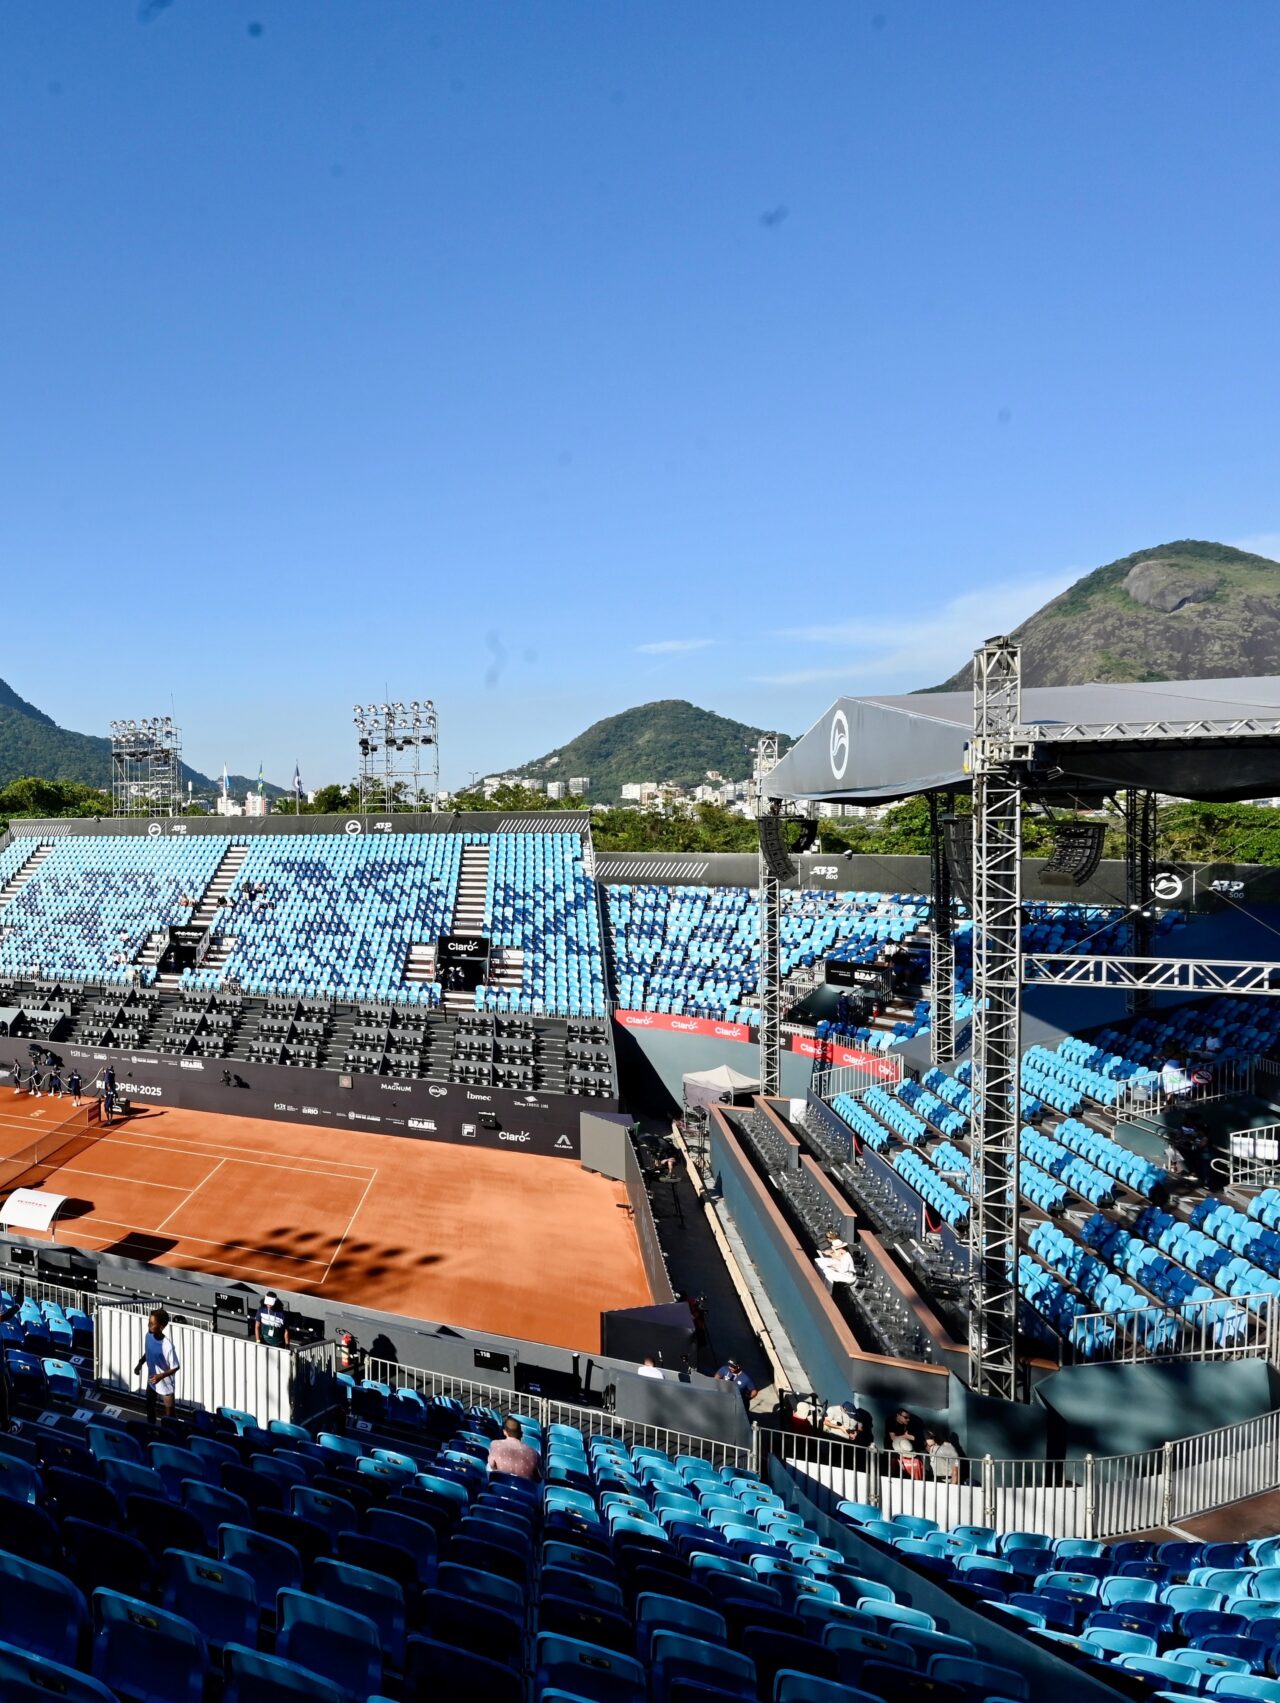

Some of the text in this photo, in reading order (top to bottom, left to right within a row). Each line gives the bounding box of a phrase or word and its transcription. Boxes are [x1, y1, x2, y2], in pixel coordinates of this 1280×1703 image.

[810, 866, 838, 874] ATP
[1208, 880, 1244, 891] ATP
[448, 940, 478, 951] Claro
[626, 1016, 653, 1025] Claro
[672, 1021, 698, 1030] Claro
[715, 1026, 740, 1037] Claro
[381, 1084, 411, 1092] MAGNUM
[499, 1131, 528, 1142] Claro
